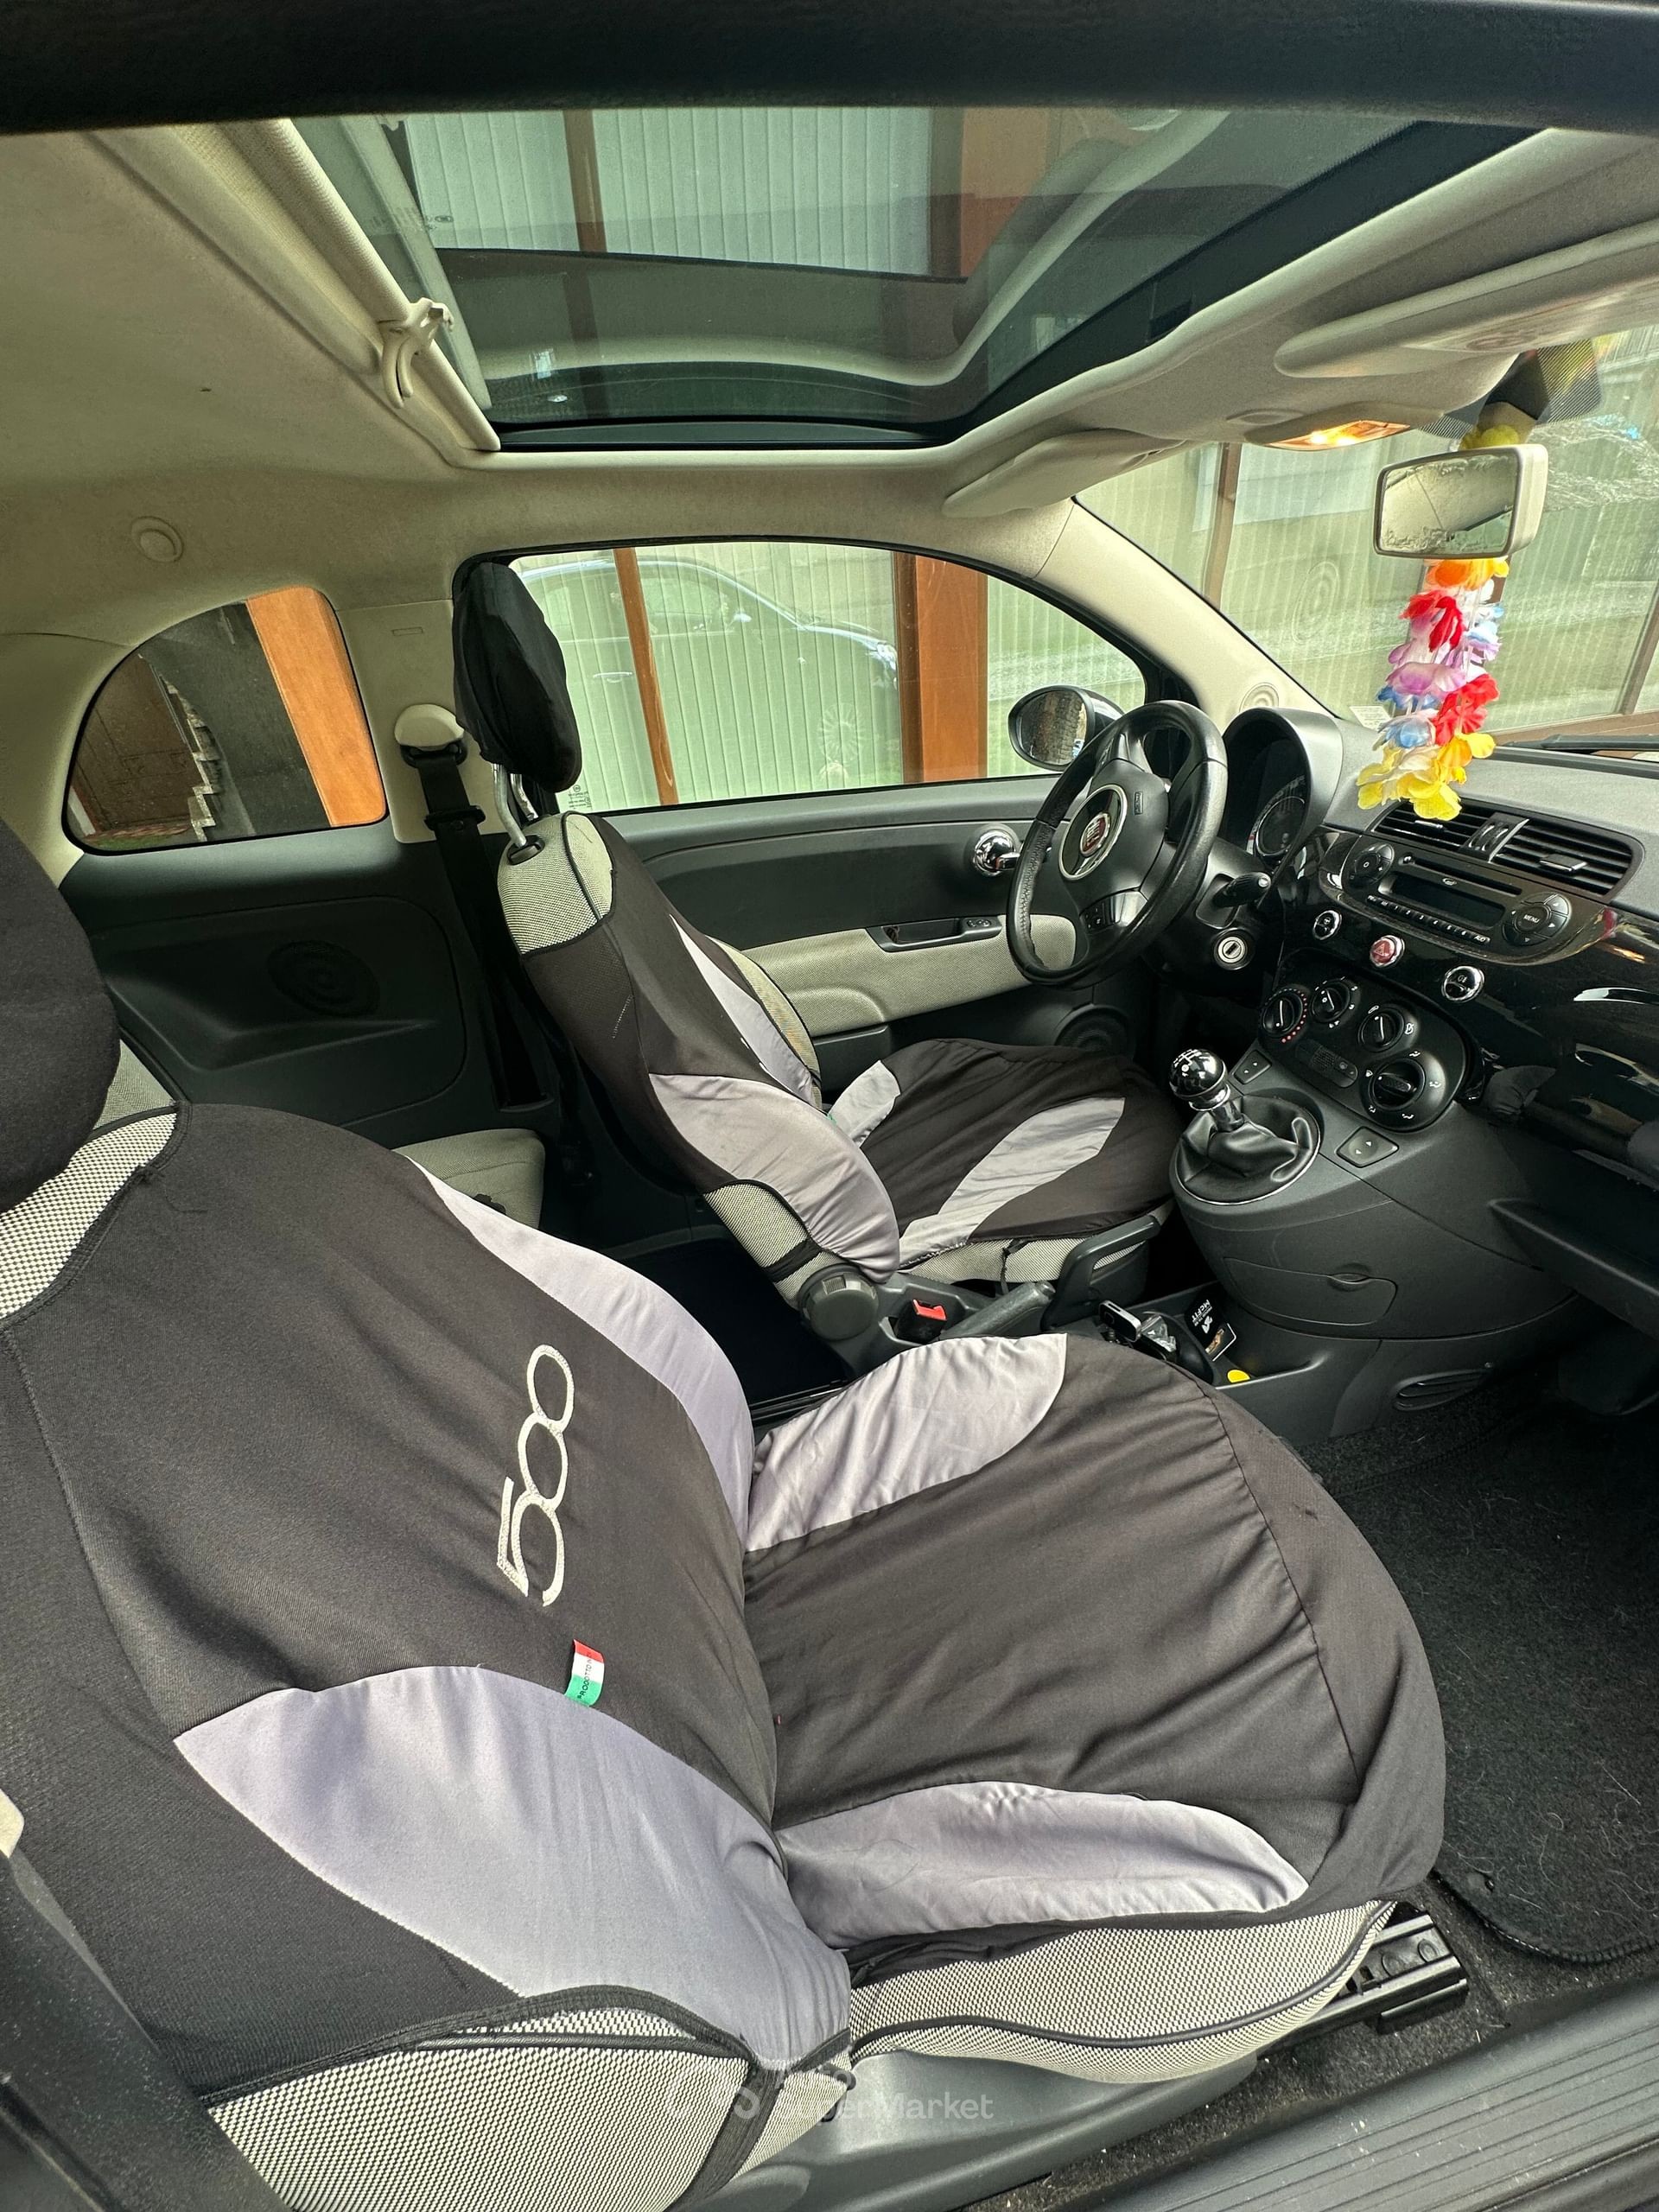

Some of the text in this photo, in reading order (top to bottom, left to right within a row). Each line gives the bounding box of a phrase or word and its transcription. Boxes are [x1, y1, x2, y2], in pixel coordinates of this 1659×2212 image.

[1523, 914, 1540, 924] MENU
[496, 1344, 575, 1607] 500
[576, 1664, 592, 1700] PRODOTTO
